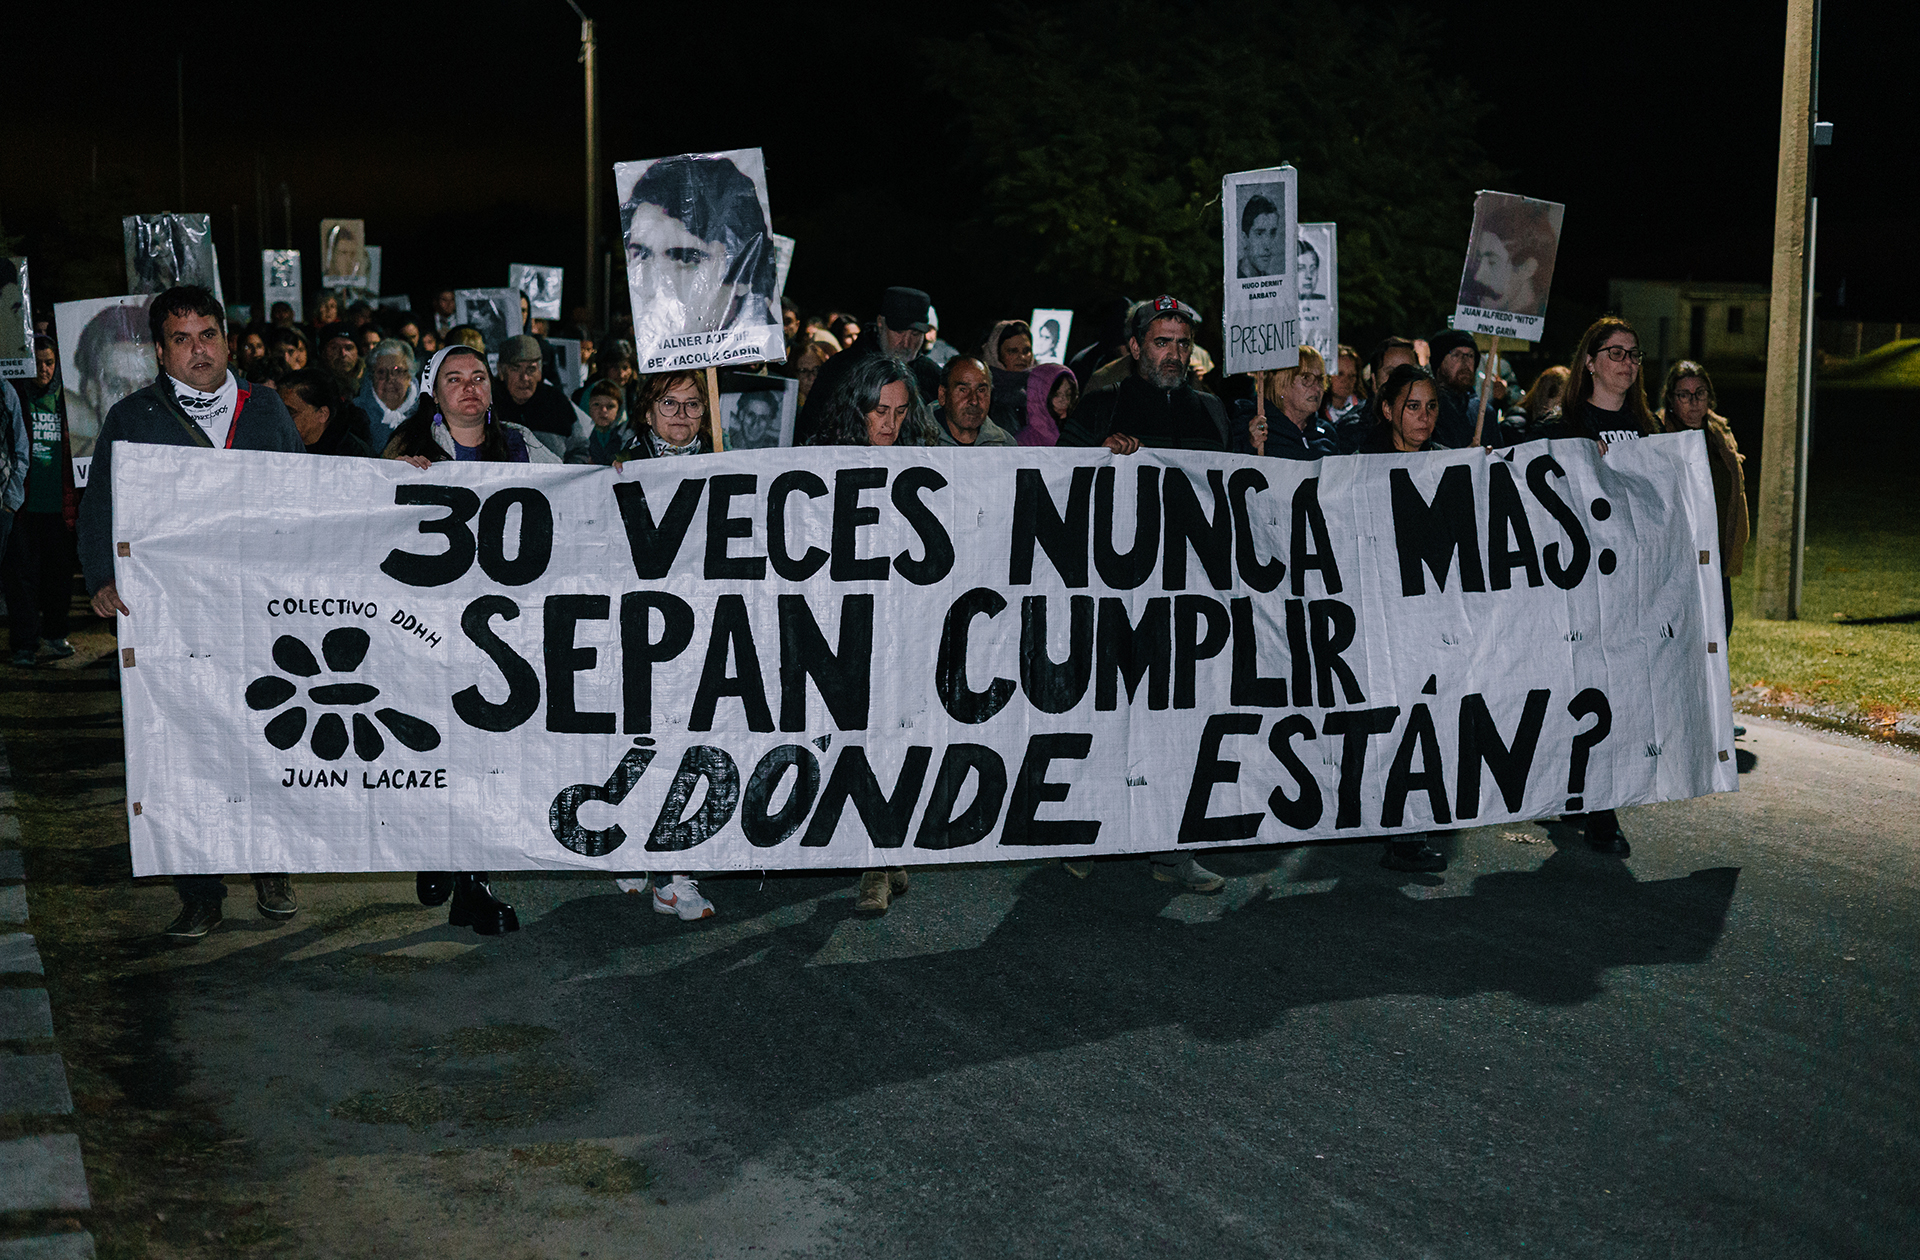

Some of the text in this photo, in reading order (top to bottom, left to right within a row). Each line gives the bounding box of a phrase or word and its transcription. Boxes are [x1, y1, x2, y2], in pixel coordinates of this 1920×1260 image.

[1242, 279, 1283, 290] HUGO DERMIT
[1249, 291, 1277, 300] BARBATO
[1461, 307, 1482, 317] JUAN
[1482, 310, 1513, 322] ALFREDO
[1477, 323, 1517, 337] PINO GARÍN
[1230, 319, 1296, 358] PRESENTE
[379, 447, 1617, 597] 30 VECES NUNCA MÁS:
[267, 598, 442, 648] COLECTIVO DDHH
[451, 587, 1367, 734] SEPAN CUMPLIR
[282, 767, 448, 790] JUAN LACAZE
[548, 673, 1612, 857] ¿DÓNDE ESTÁN?
